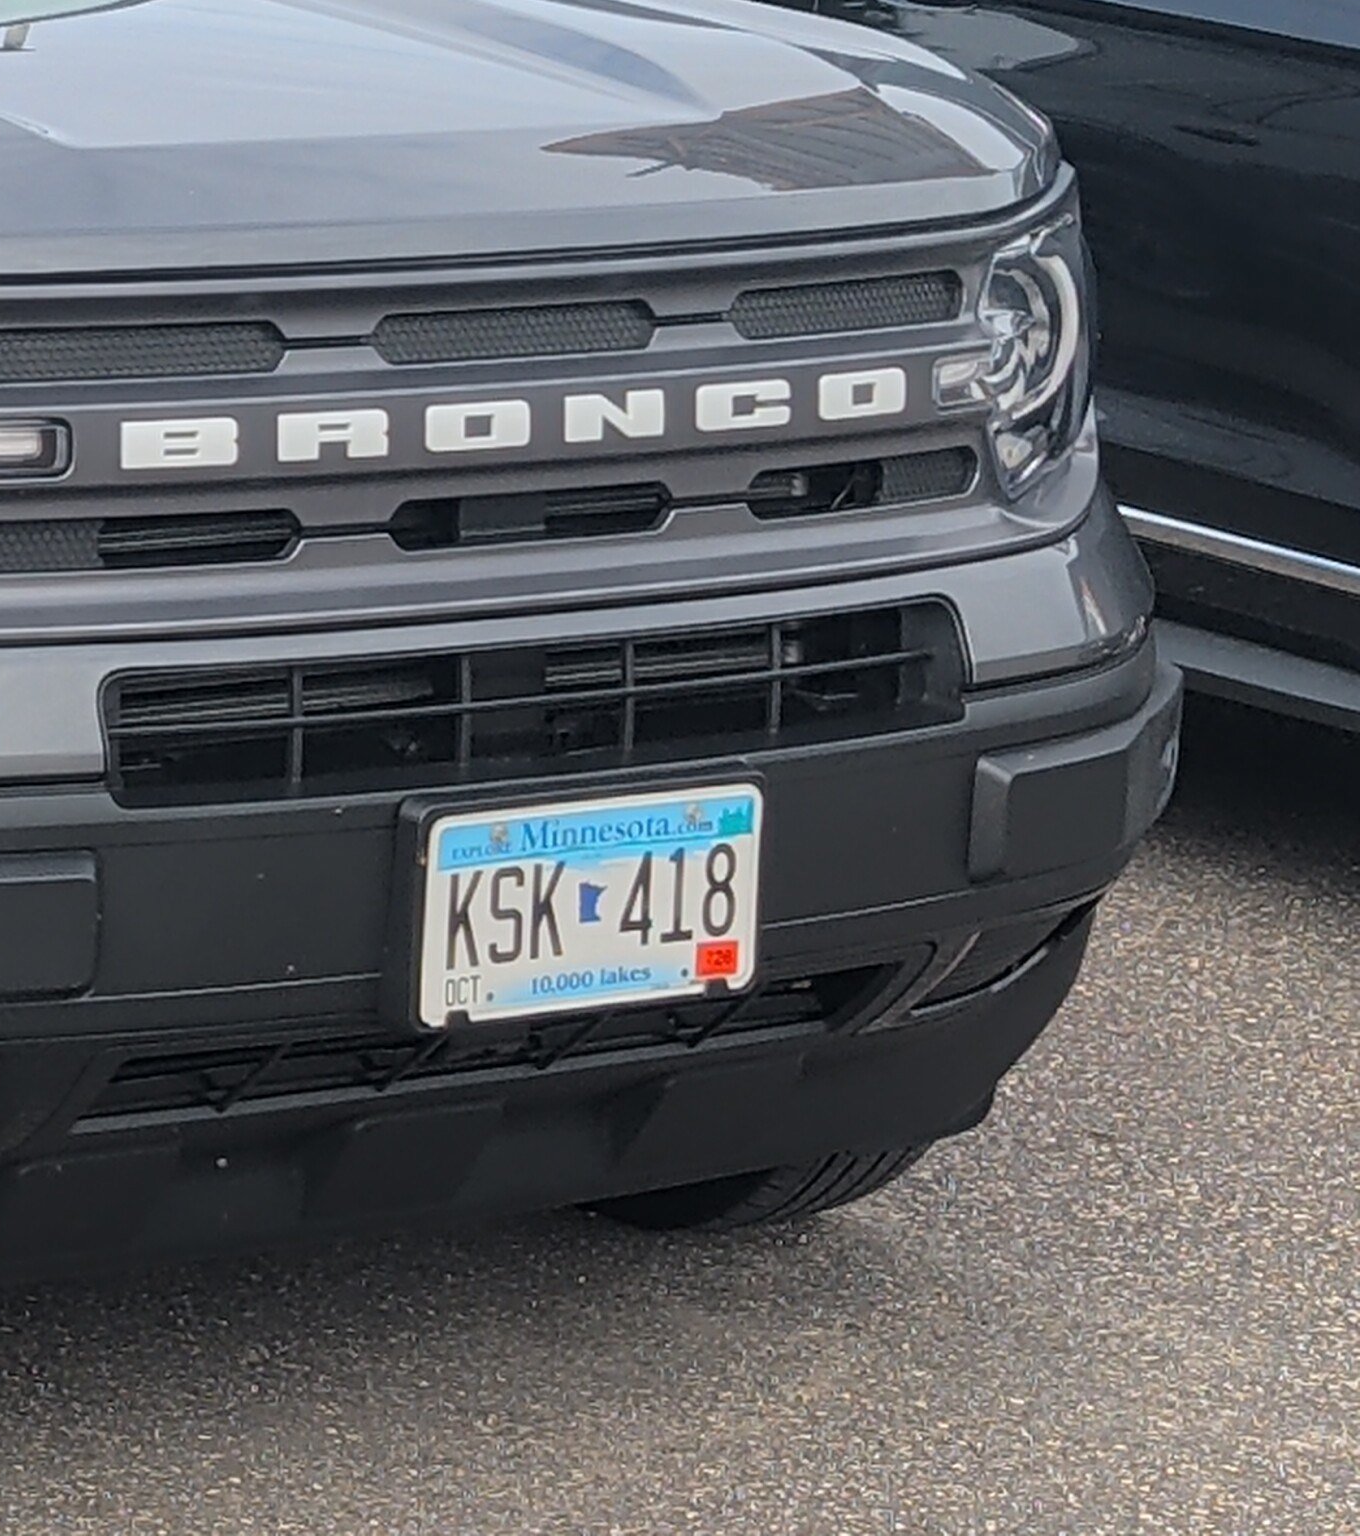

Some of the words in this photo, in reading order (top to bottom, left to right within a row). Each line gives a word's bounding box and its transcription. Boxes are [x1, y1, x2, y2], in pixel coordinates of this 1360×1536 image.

[120, 367, 908, 470] BRONCO
[445, 860, 566, 971] KSK
[619, 843, 736, 946] 418
[445, 974, 481, 1007] OCT
[600, 965, 652, 986] lakes
